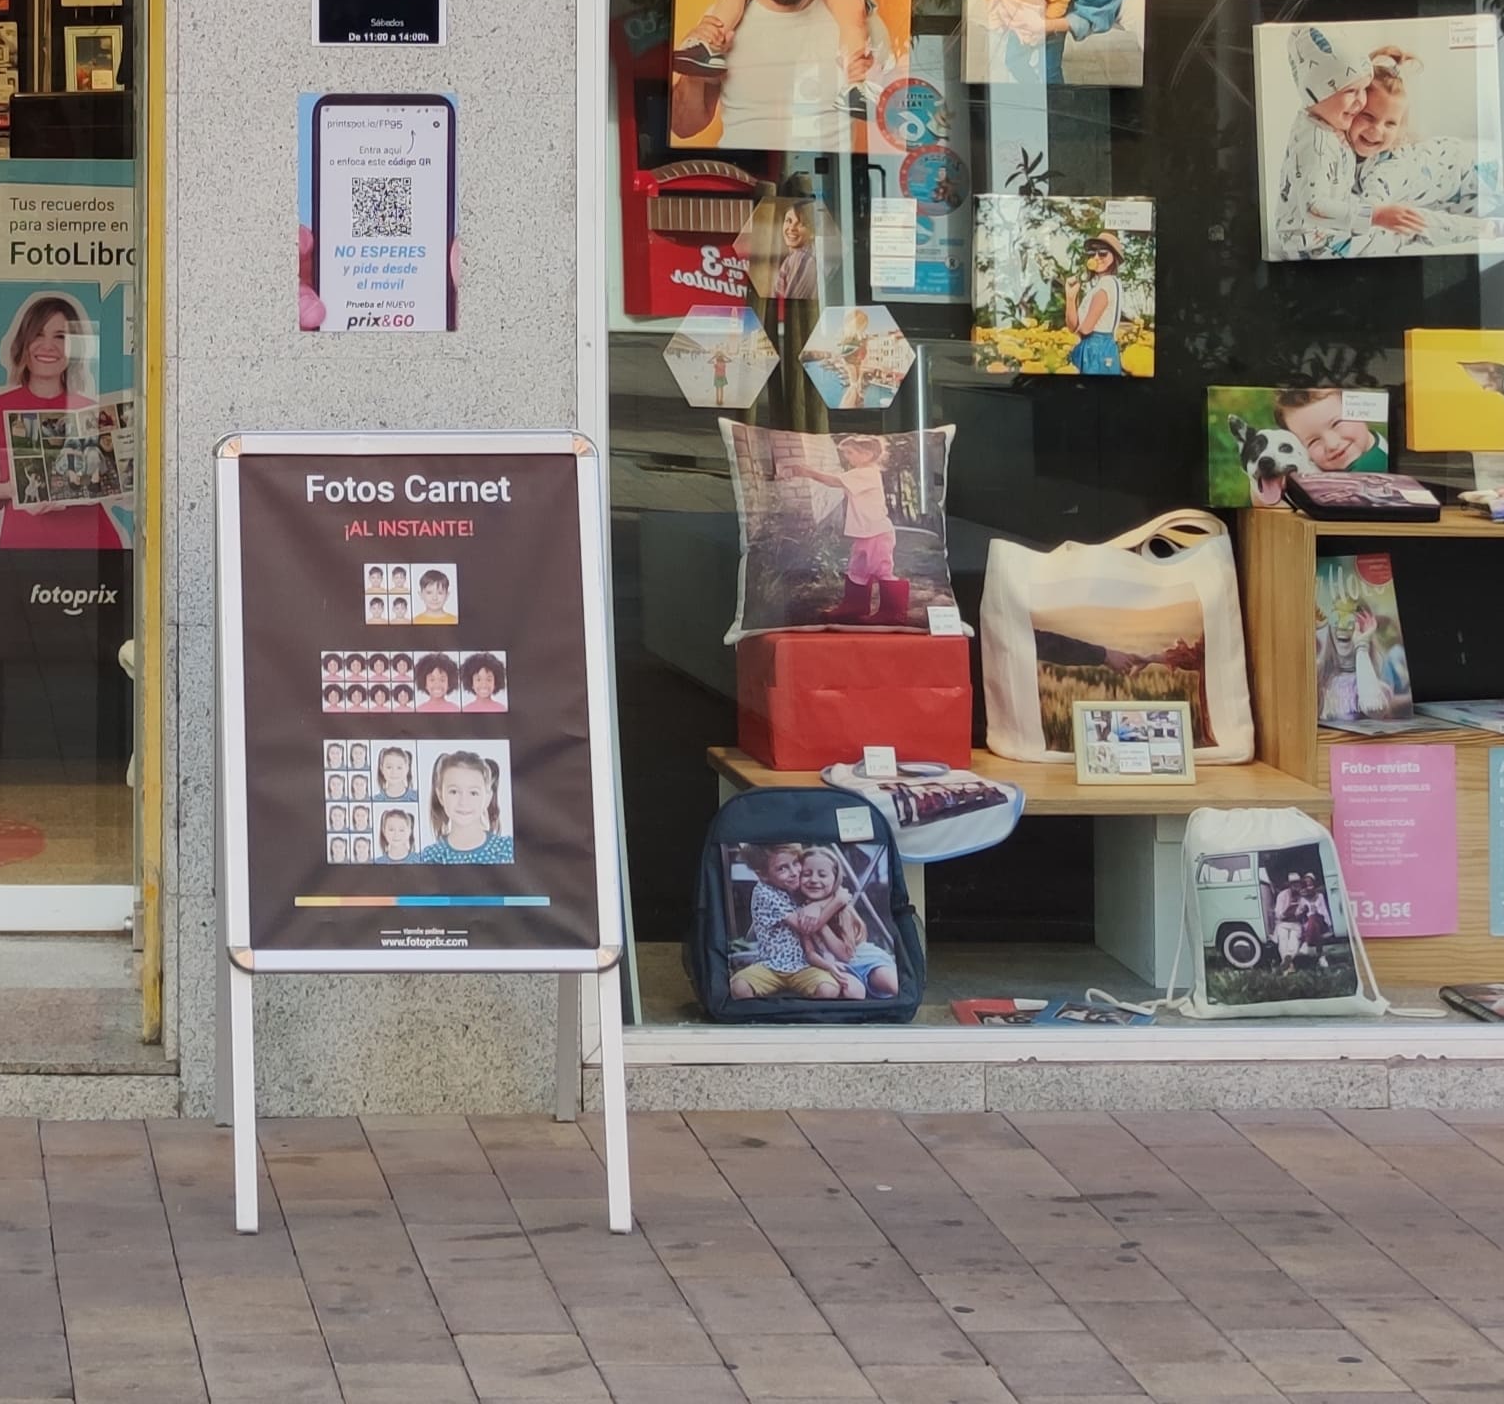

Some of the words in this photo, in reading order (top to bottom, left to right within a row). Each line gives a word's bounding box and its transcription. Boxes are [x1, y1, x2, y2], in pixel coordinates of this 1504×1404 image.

[370, 18, 404, 28] Sábados
[348, 32, 361, 42] De
[364, 32, 388, 42] 11:00
[359, 146, 381, 155] Entra
[337, 157, 366, 166] enfoca
[367, 158, 386, 166] este
[388, 157, 416, 168] código
[418, 158, 432, 166] QR
[9, 197, 37, 212] Tus
[41, 197, 115, 212] recuerdos
[9, 219, 42, 234] para
[46, 217, 106, 235] siempre
[110, 220, 129, 232] en
[334, 245, 356, 258] NO
[360, 245, 427, 258] ESPERES
[343, 265, 350, 276] y
[352, 262, 379, 277] pide
[382, 262, 418, 274] desde
[356, 279, 368, 290] el
[370, 278, 405, 290] móvil
[345, 300, 375, 309] Prueba
[376, 300, 384, 309] el
[385, 300, 415, 309] NUEVO
[346, 313, 415, 330] prix&GO
[305, 474, 395, 504] Fotos
[403, 474, 512, 504] Carnet
[344, 519, 373, 541] ¡AL
[378, 518, 474, 538] INSTANTE!
[30, 583, 118, 609] fotoprix
[1341, 761, 1421, 774] Foto-revista
[380, 936, 469, 949] www.fotoprix.com
